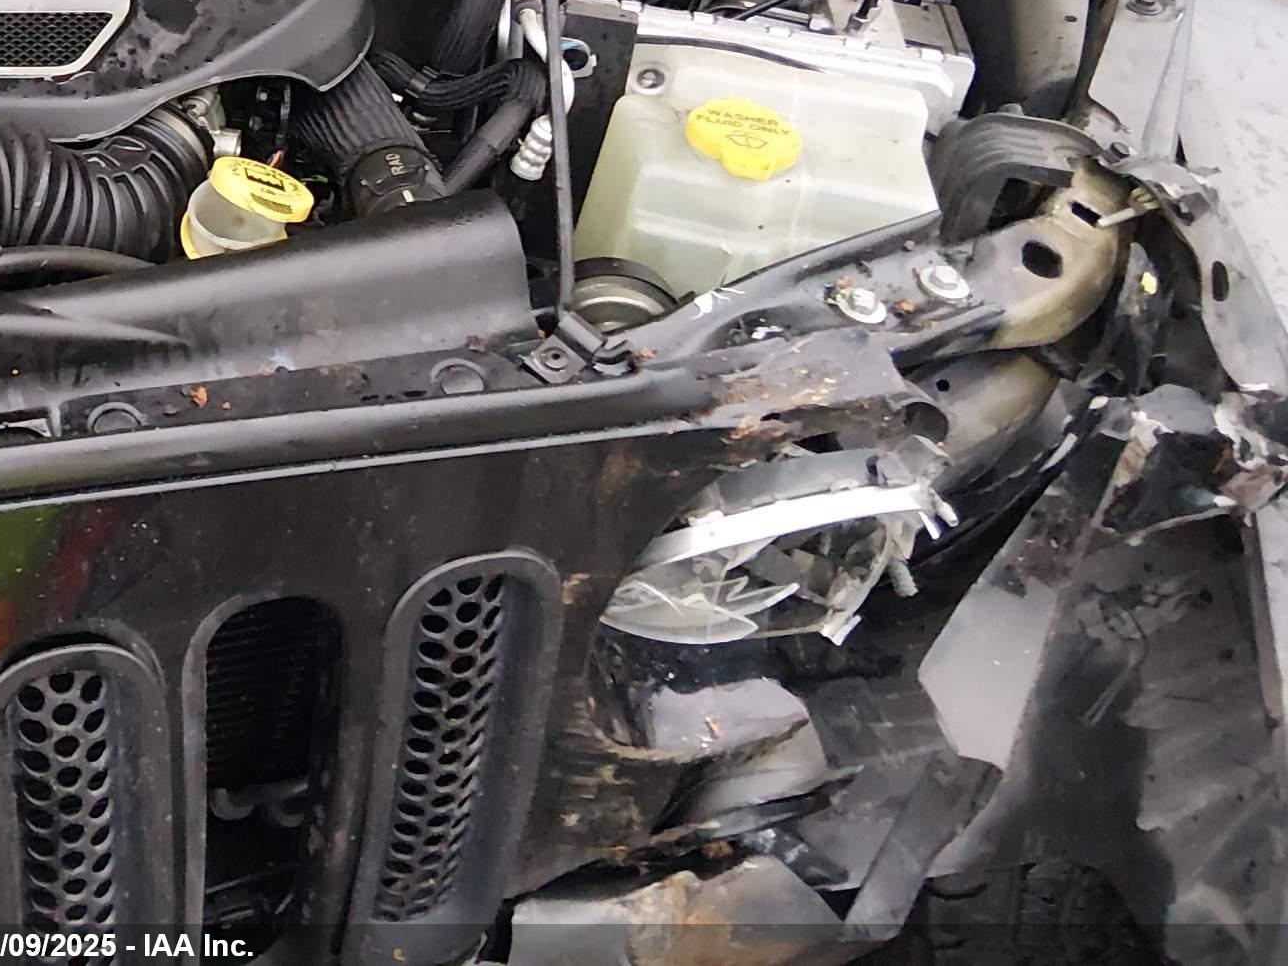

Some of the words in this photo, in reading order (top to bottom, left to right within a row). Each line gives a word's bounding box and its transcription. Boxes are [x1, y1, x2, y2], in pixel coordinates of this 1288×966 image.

[696, 114, 743, 127] FLUID
[749, 124, 791, 136] ONLY
[707, 110, 779, 126] WASHER
[385, 153, 405, 176] RAD
